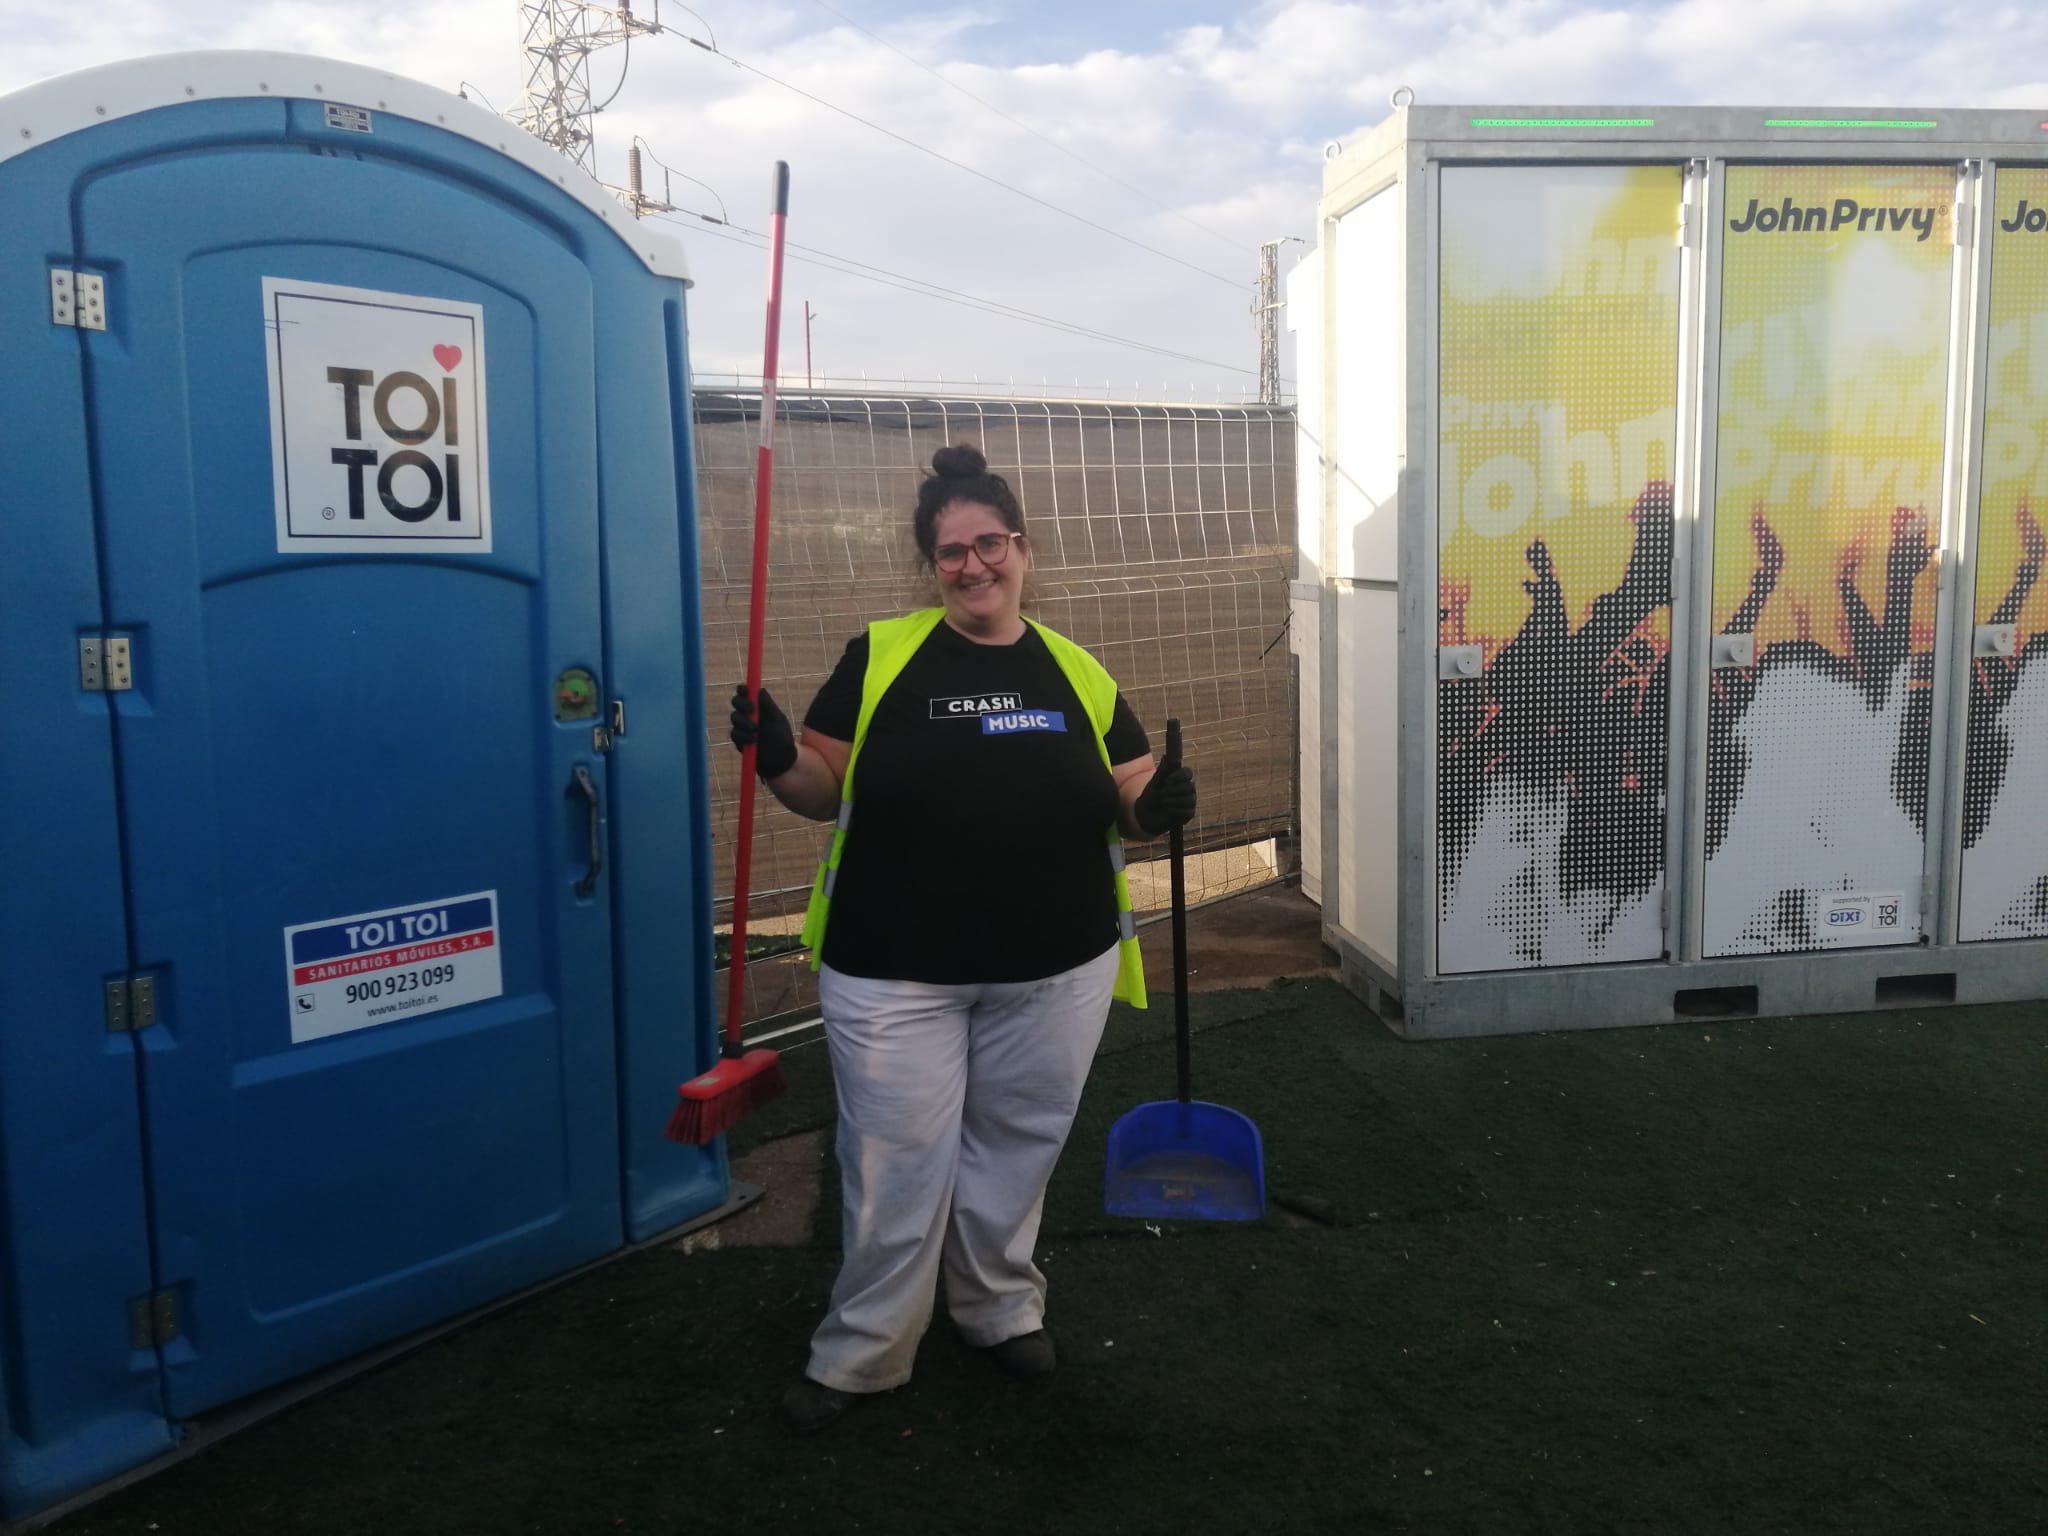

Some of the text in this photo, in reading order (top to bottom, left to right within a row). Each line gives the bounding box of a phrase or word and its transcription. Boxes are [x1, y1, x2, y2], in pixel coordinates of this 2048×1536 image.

[2001, 199, 2048, 233] Jo
[331, 447, 462, 523] TOI
[948, 697, 1016, 713] CRASH
[988, 715, 1050, 732] MUSIC
[345, 910, 449, 950] TOI TOI
[1878, 915, 1897, 926] TOI
[308, 954, 392, 981] SANITARIOS
[461, 936, 487, 951] S.A.
[346, 964, 455, 1004] 900 923 099
[367, 995, 439, 1017] www.toitoi.es
